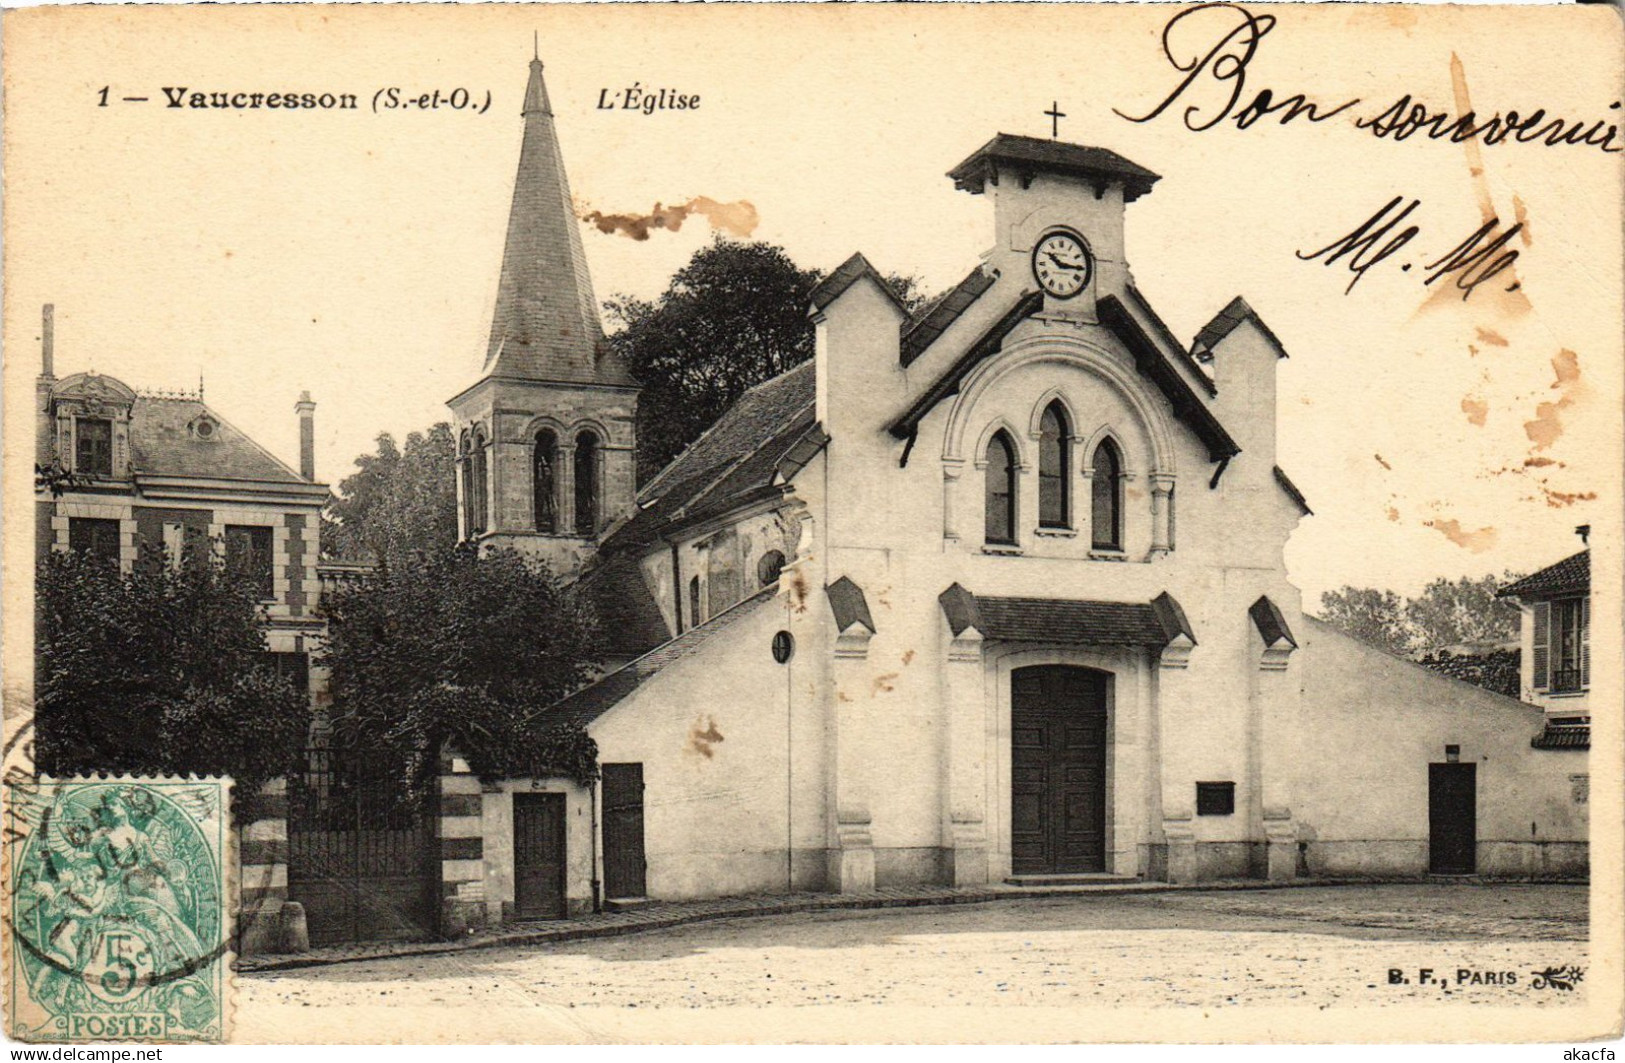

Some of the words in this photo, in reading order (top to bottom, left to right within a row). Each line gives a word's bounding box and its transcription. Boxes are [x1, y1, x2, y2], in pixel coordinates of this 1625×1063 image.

[1111, 3, 1360, 132] Bon
[1355, 94, 1624, 153] souvenir
[98, 85, 109, 108] 1
[161, 86, 358, 110] Vaucresson
[1456, 967, 1518, 986] PARIS
[70, 1014, 163, 1037] POSTES
